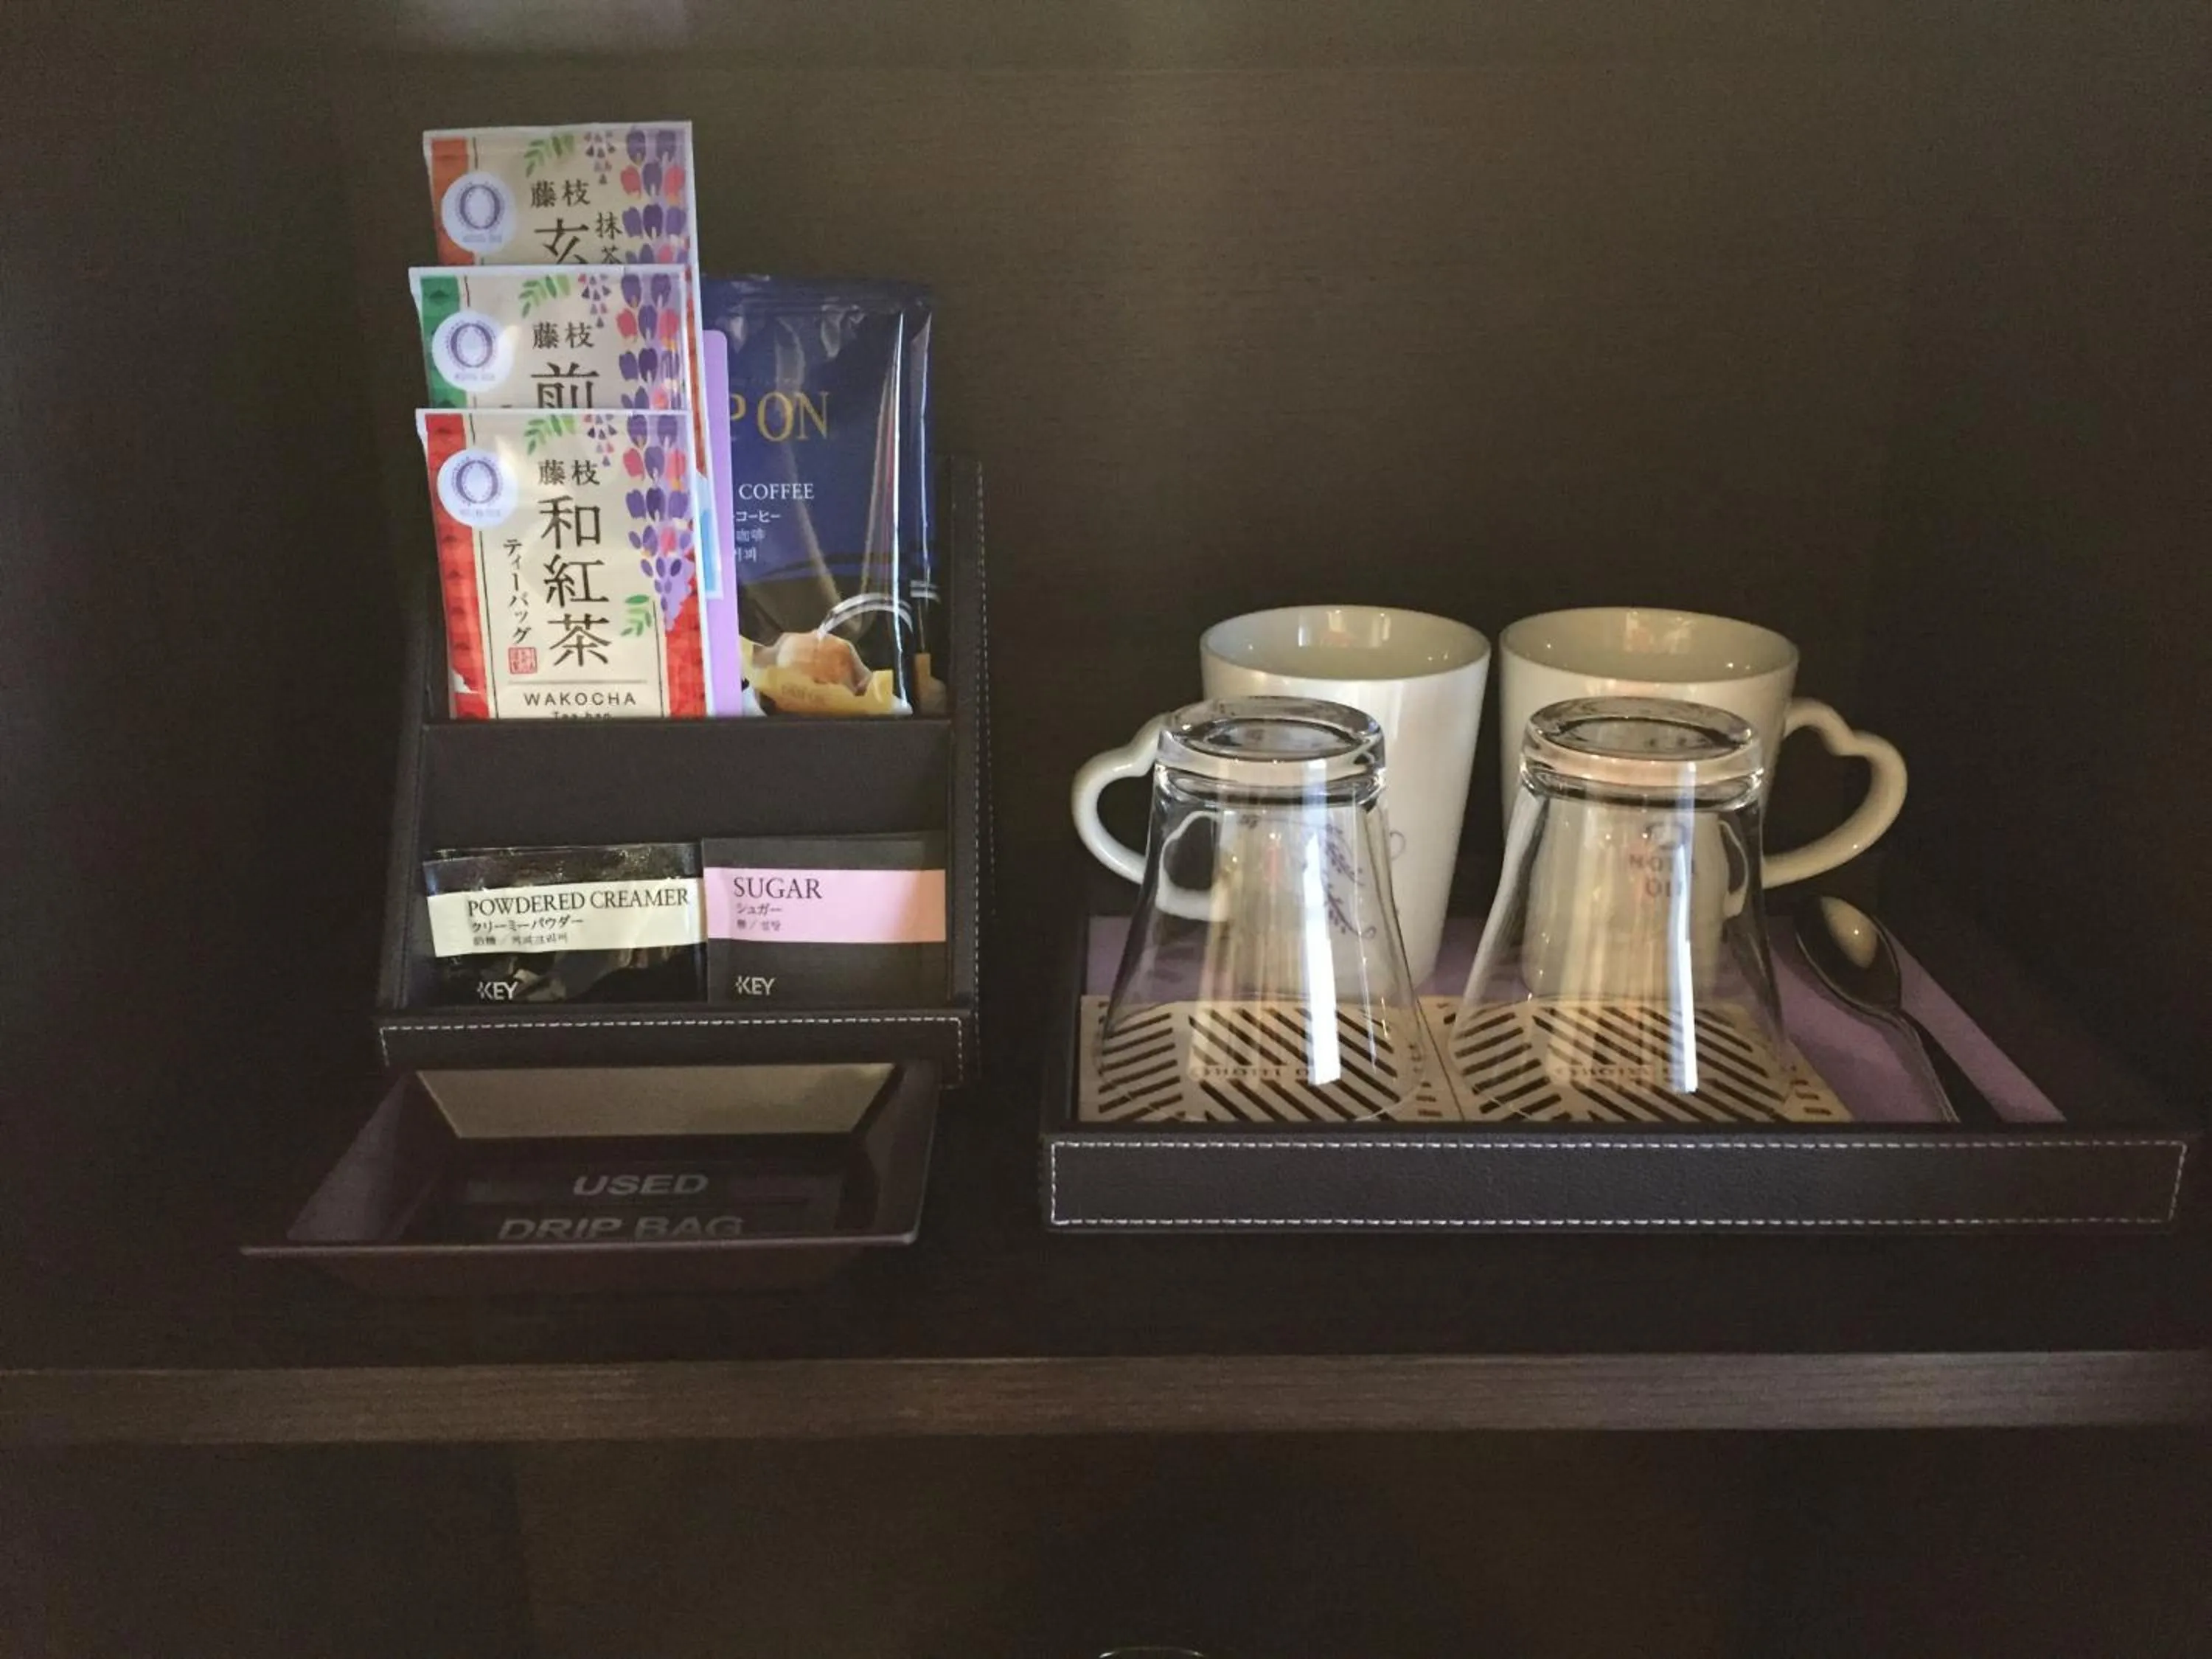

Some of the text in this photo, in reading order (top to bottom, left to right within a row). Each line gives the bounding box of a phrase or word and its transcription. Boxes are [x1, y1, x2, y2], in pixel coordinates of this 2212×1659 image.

[530, 179, 591, 208] 藤枝
[532, 321, 595, 350] 藤枝
[757, 391, 829, 442] ON
[538, 459, 600, 486] 藤枝
[738, 483, 815, 501] COFFEE
[503, 538, 532, 644] ティーバッグ
[538, 495, 613, 667] 和紅茶
[524, 692, 637, 706] WAKOCHA
[733, 876, 823, 900] SUGAR
[467, 888, 689, 917] POWDERED CREAMER
[736, 902, 783, 917] シュガー
[478, 981, 518, 1001] KEY
[735, 975, 775, 995] KEY
[572, 1174, 709, 1196] USED
[497, 1215, 745, 1240] DRIP BAG
